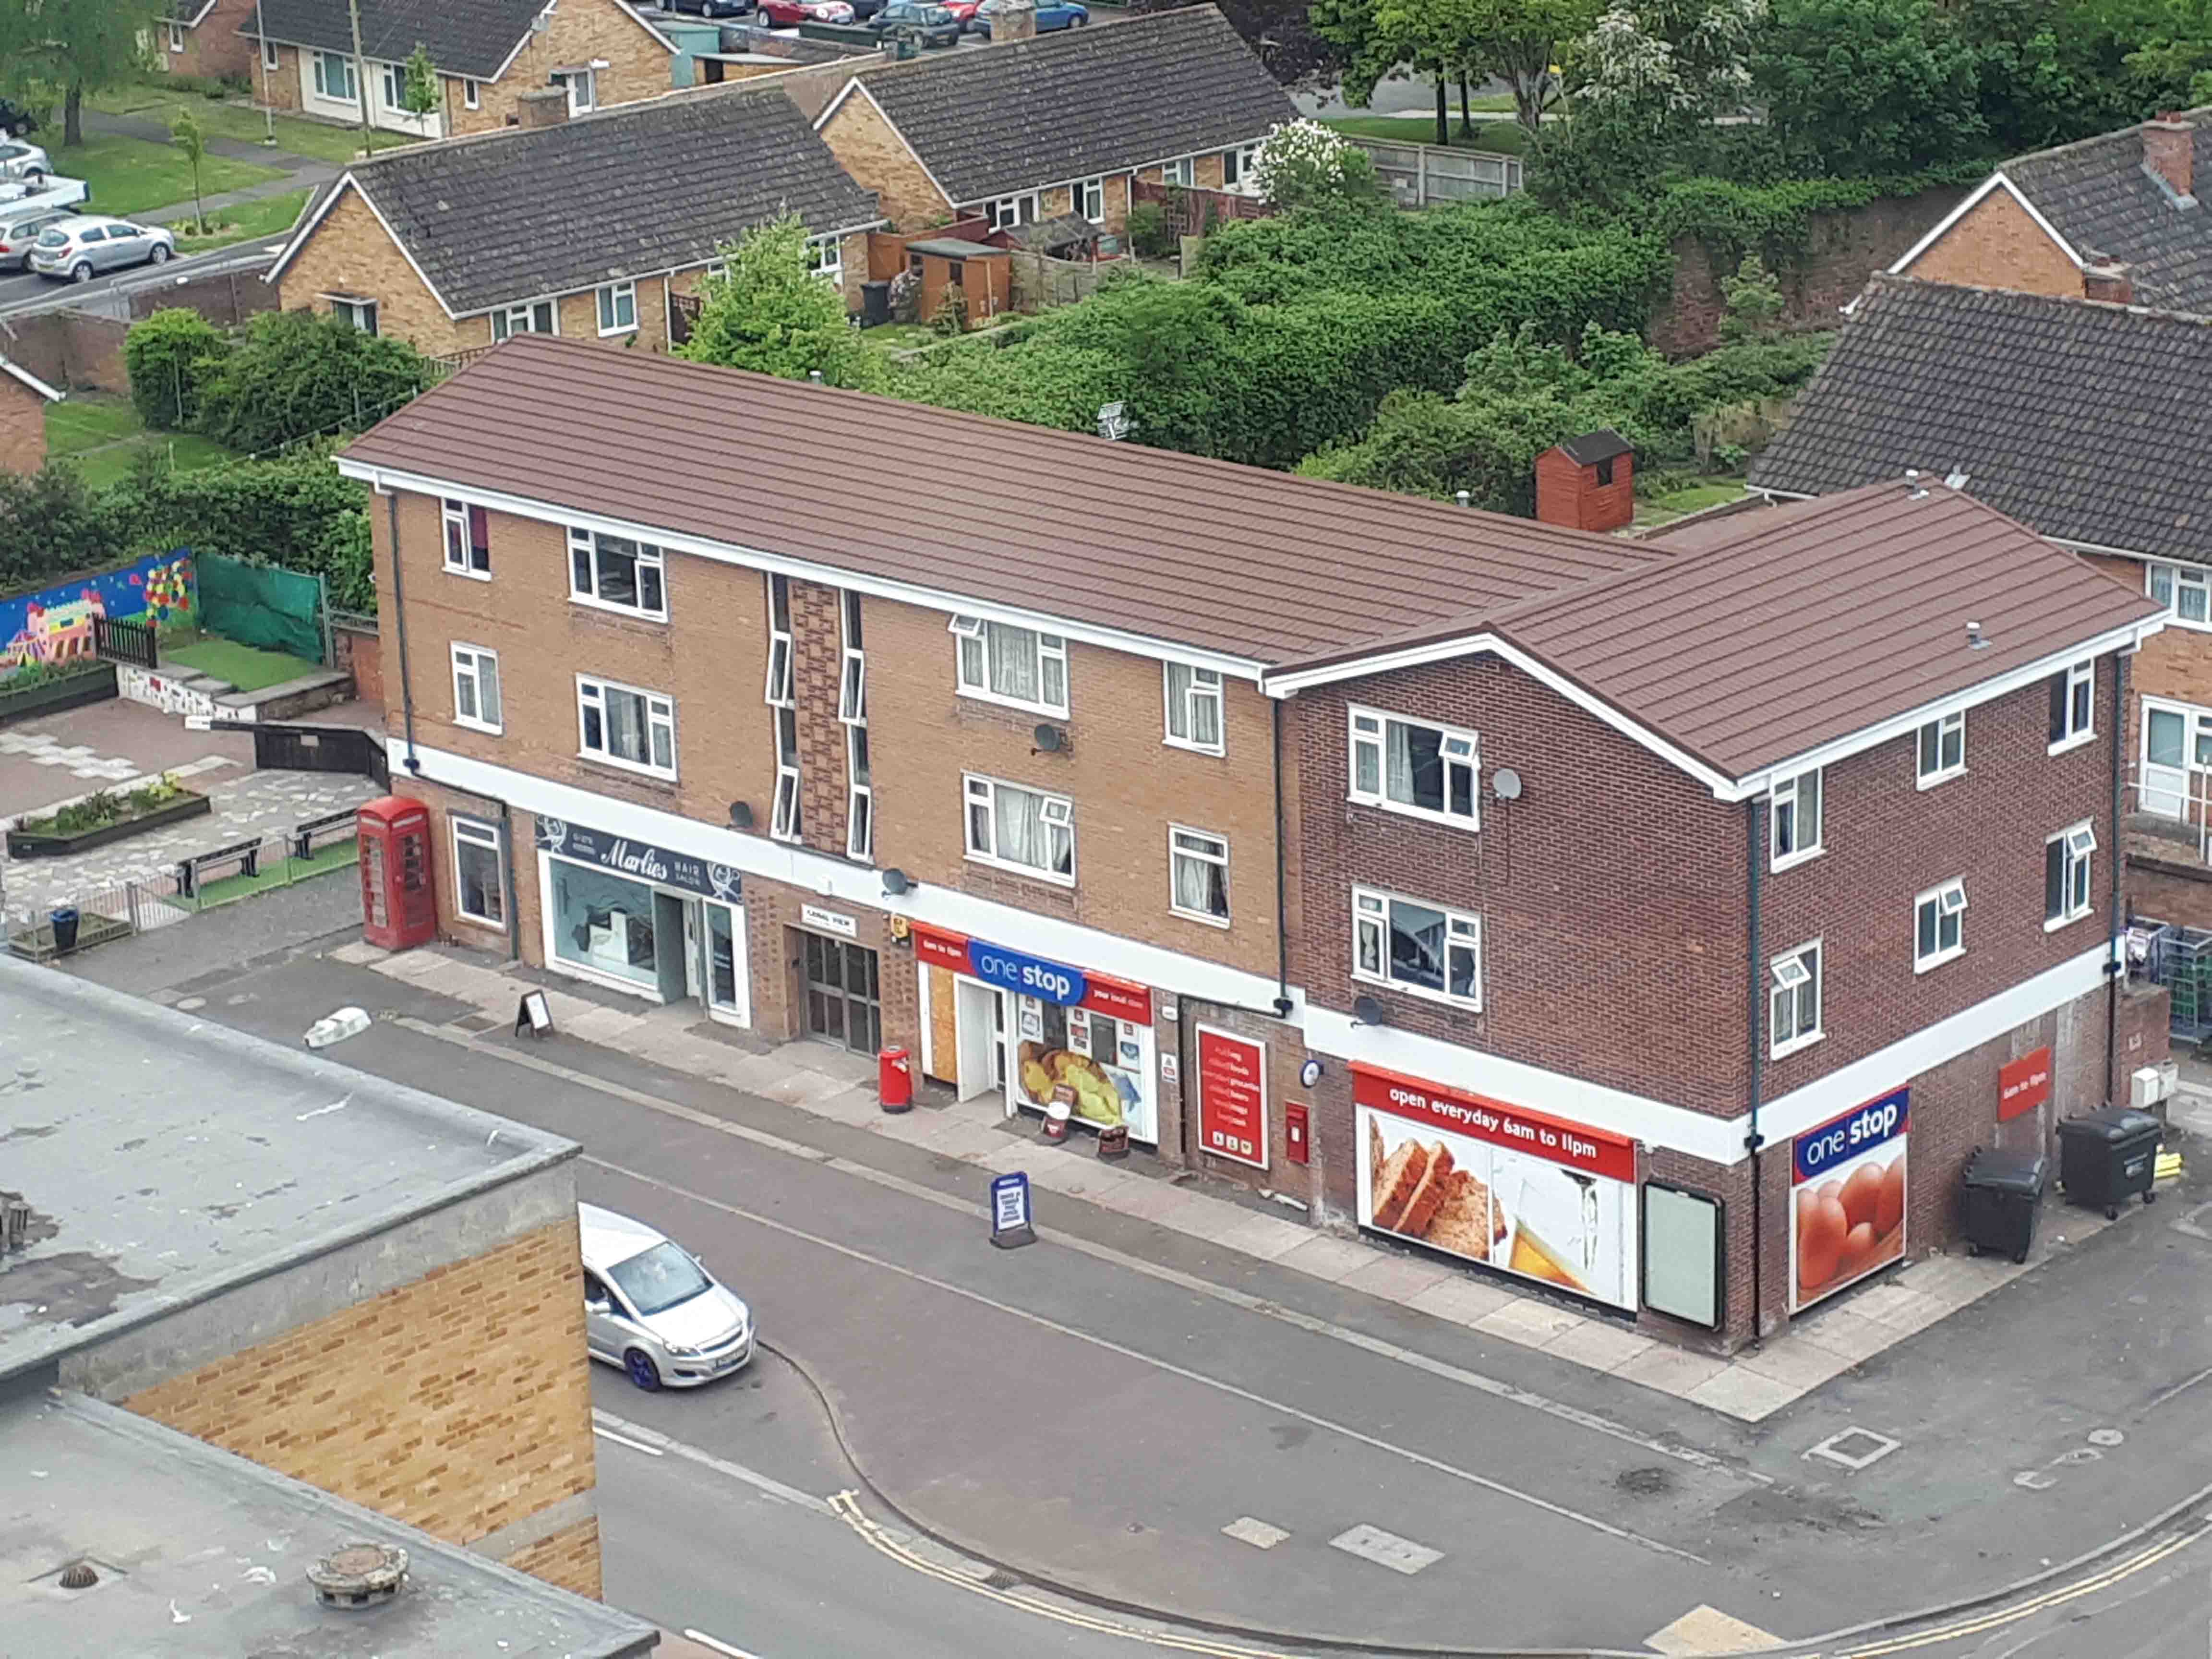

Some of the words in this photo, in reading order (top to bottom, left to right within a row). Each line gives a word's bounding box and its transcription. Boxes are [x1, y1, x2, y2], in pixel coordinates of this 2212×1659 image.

[600, 839, 668, 880] Marlies
[981, 955, 1018, 981] one
[1022, 964, 1070, 1000] stop
[1389, 1088, 1426, 1109] open
[1431, 1099, 1499, 1133] everyday
[1503, 1118, 1535, 1141] 6am
[1539, 1129, 1557, 1146] to
[1562, 1133, 1597, 1158] 11pm
[1807, 1129, 1845, 1165] one
[1849, 1104, 1898, 1144] stop
